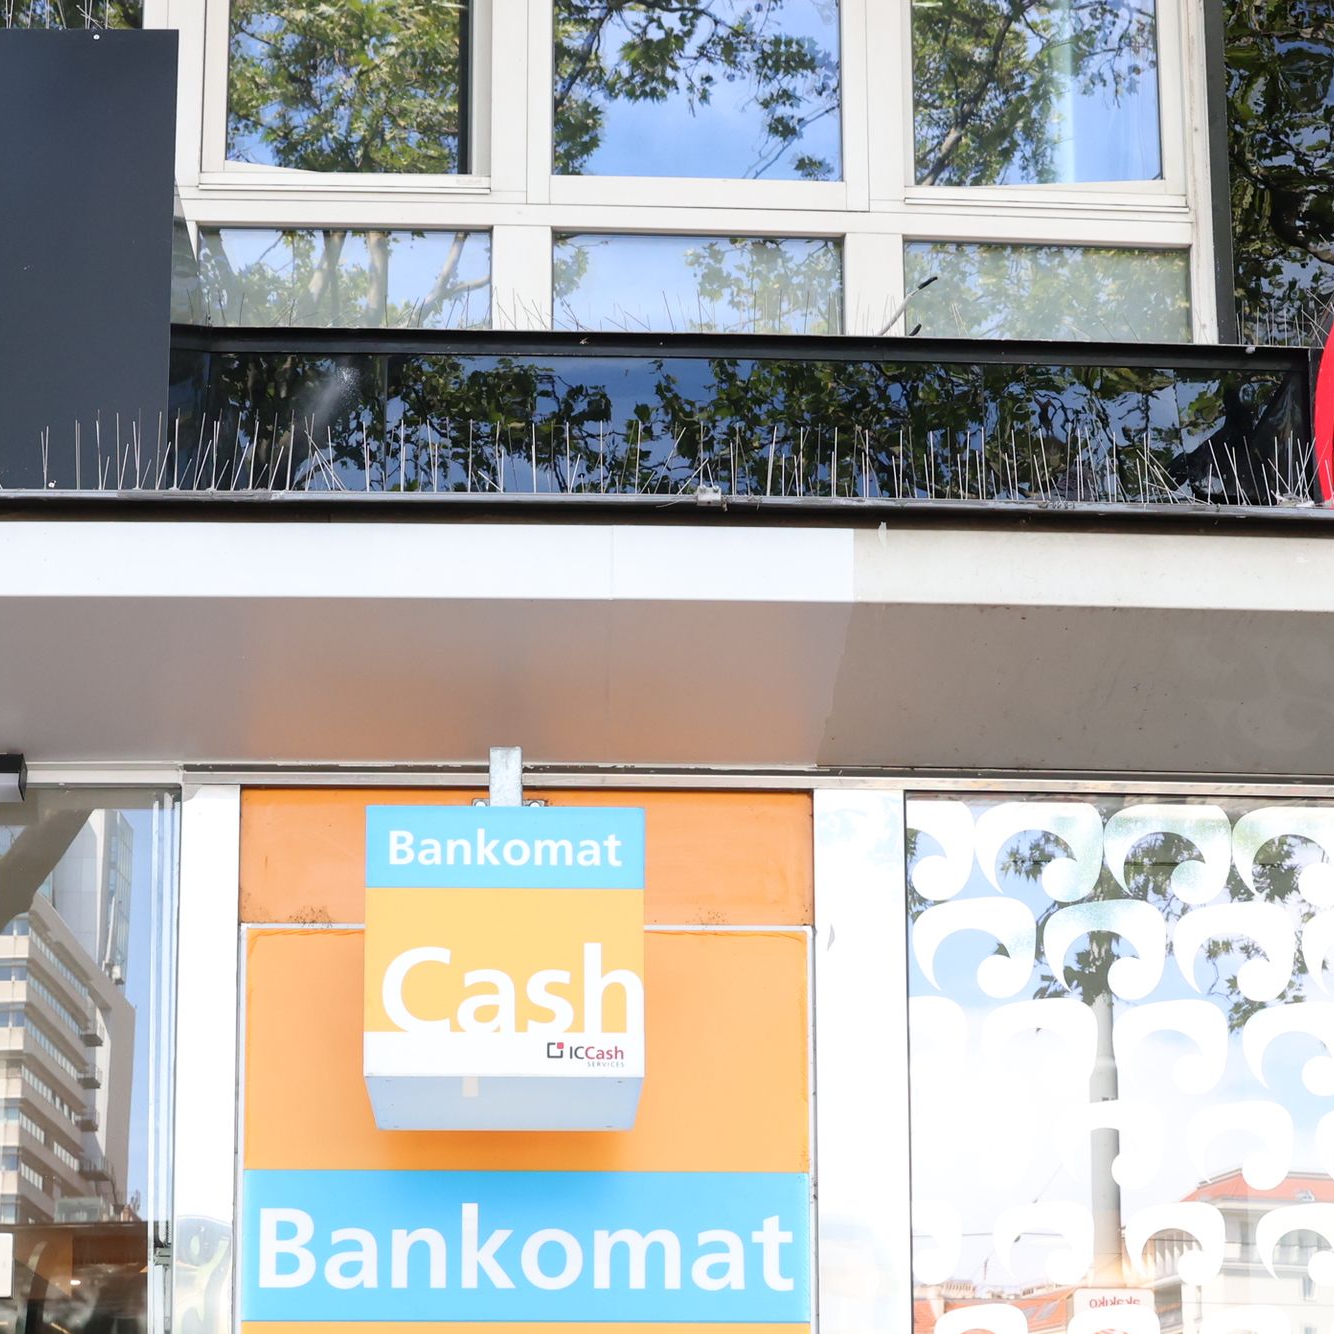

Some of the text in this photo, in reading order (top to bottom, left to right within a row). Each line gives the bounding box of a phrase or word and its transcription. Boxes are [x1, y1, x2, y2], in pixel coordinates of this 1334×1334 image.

[387, 829, 623, 868] Bankomat
[381, 942, 645, 1033] Cash
[569, 1045, 624, 1060] ICCash
[258, 1202, 795, 1291] Bankomat
